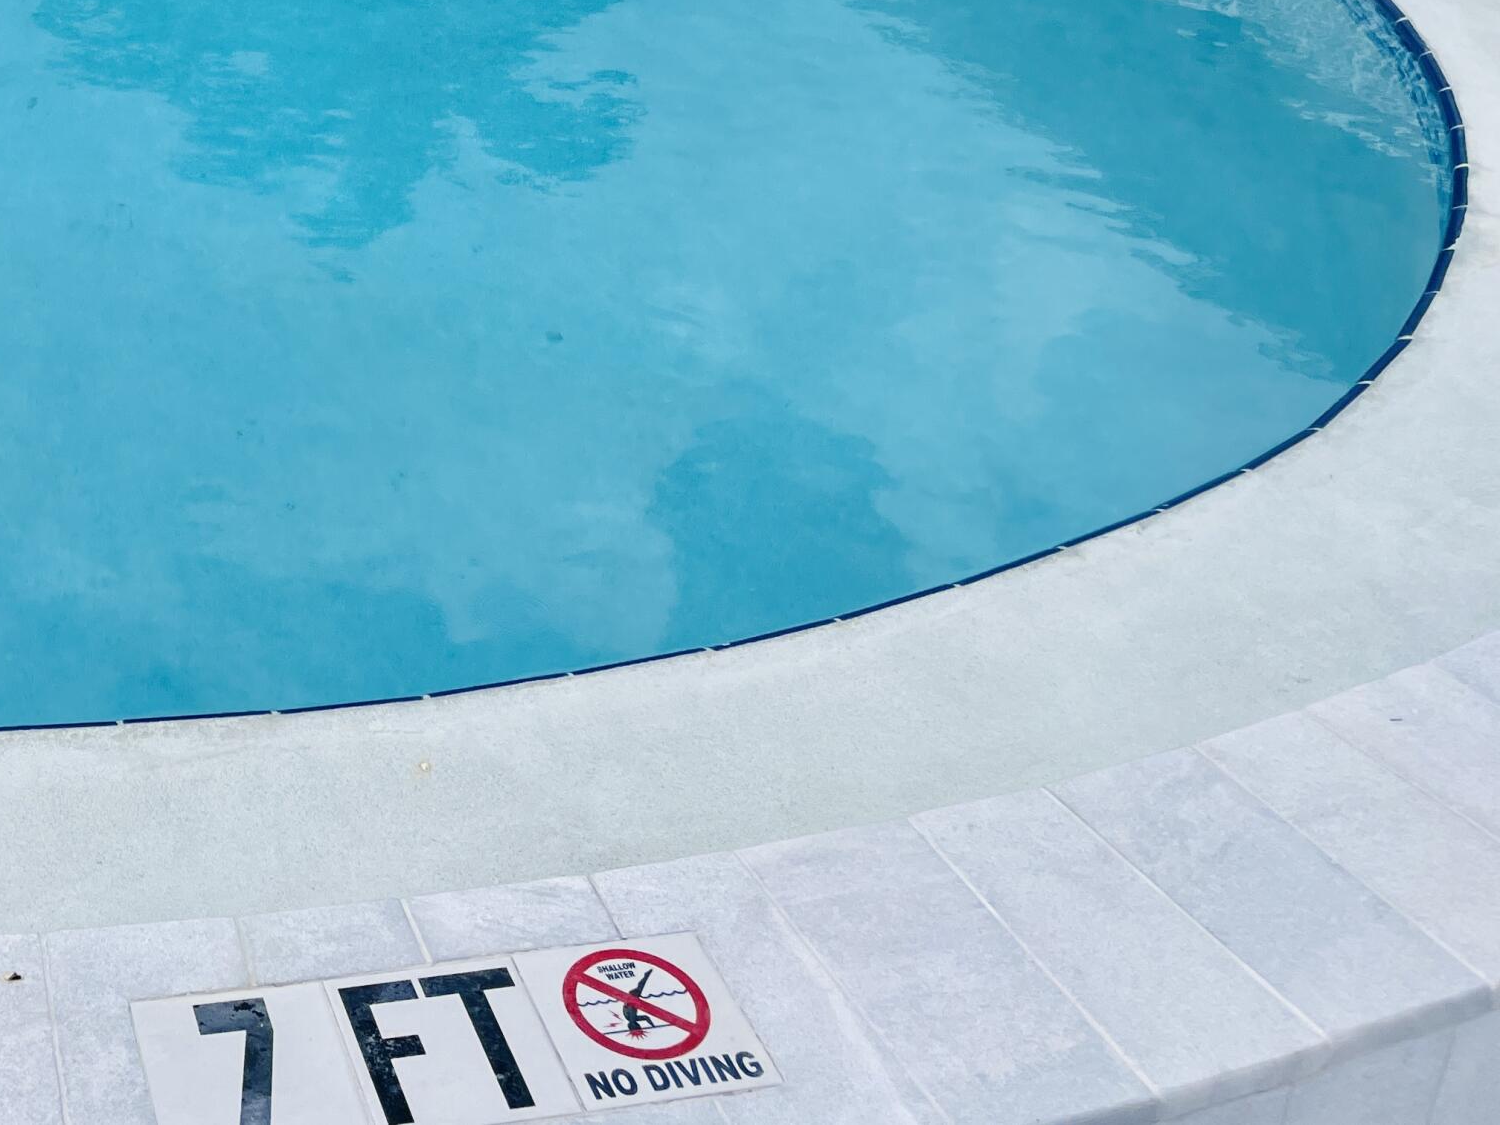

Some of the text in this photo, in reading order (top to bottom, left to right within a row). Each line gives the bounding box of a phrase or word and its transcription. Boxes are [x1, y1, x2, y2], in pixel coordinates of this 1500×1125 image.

[596, 961, 636, 974] SHALLOW
[605, 970, 636, 981] WATER
[192, 966, 536, 1125] 7 FT
[583, 1050, 765, 1100] NO DIVING
